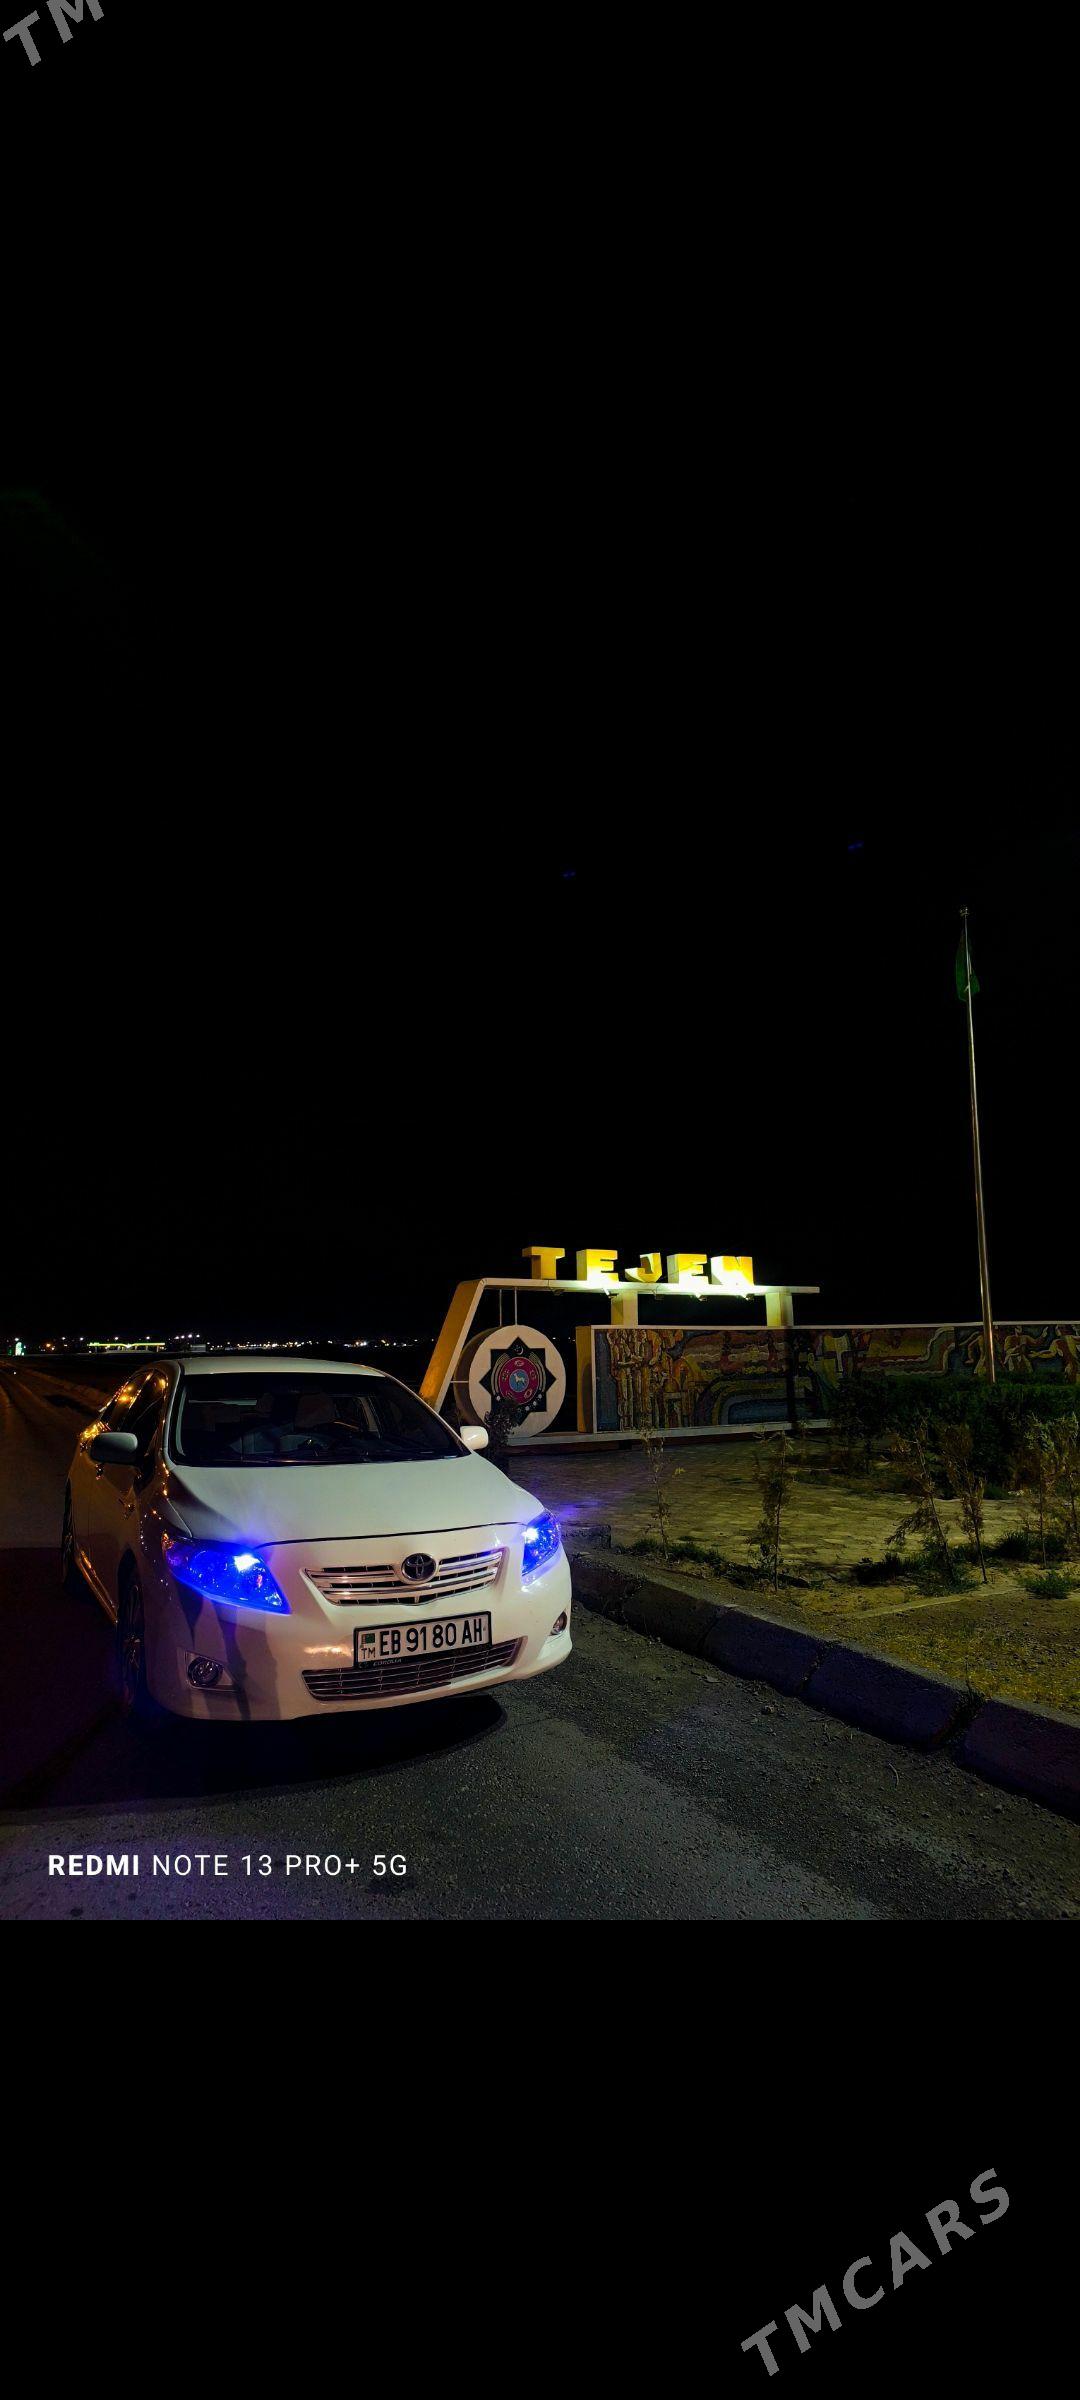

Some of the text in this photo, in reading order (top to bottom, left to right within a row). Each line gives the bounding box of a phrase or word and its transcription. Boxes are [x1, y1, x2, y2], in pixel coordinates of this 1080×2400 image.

[522, 1246, 755, 1285] TEJEN
[361, 1647, 376, 1660] TM
[379, 1630, 401, 1656] EB
[461, 1618, 483, 1645] AH
